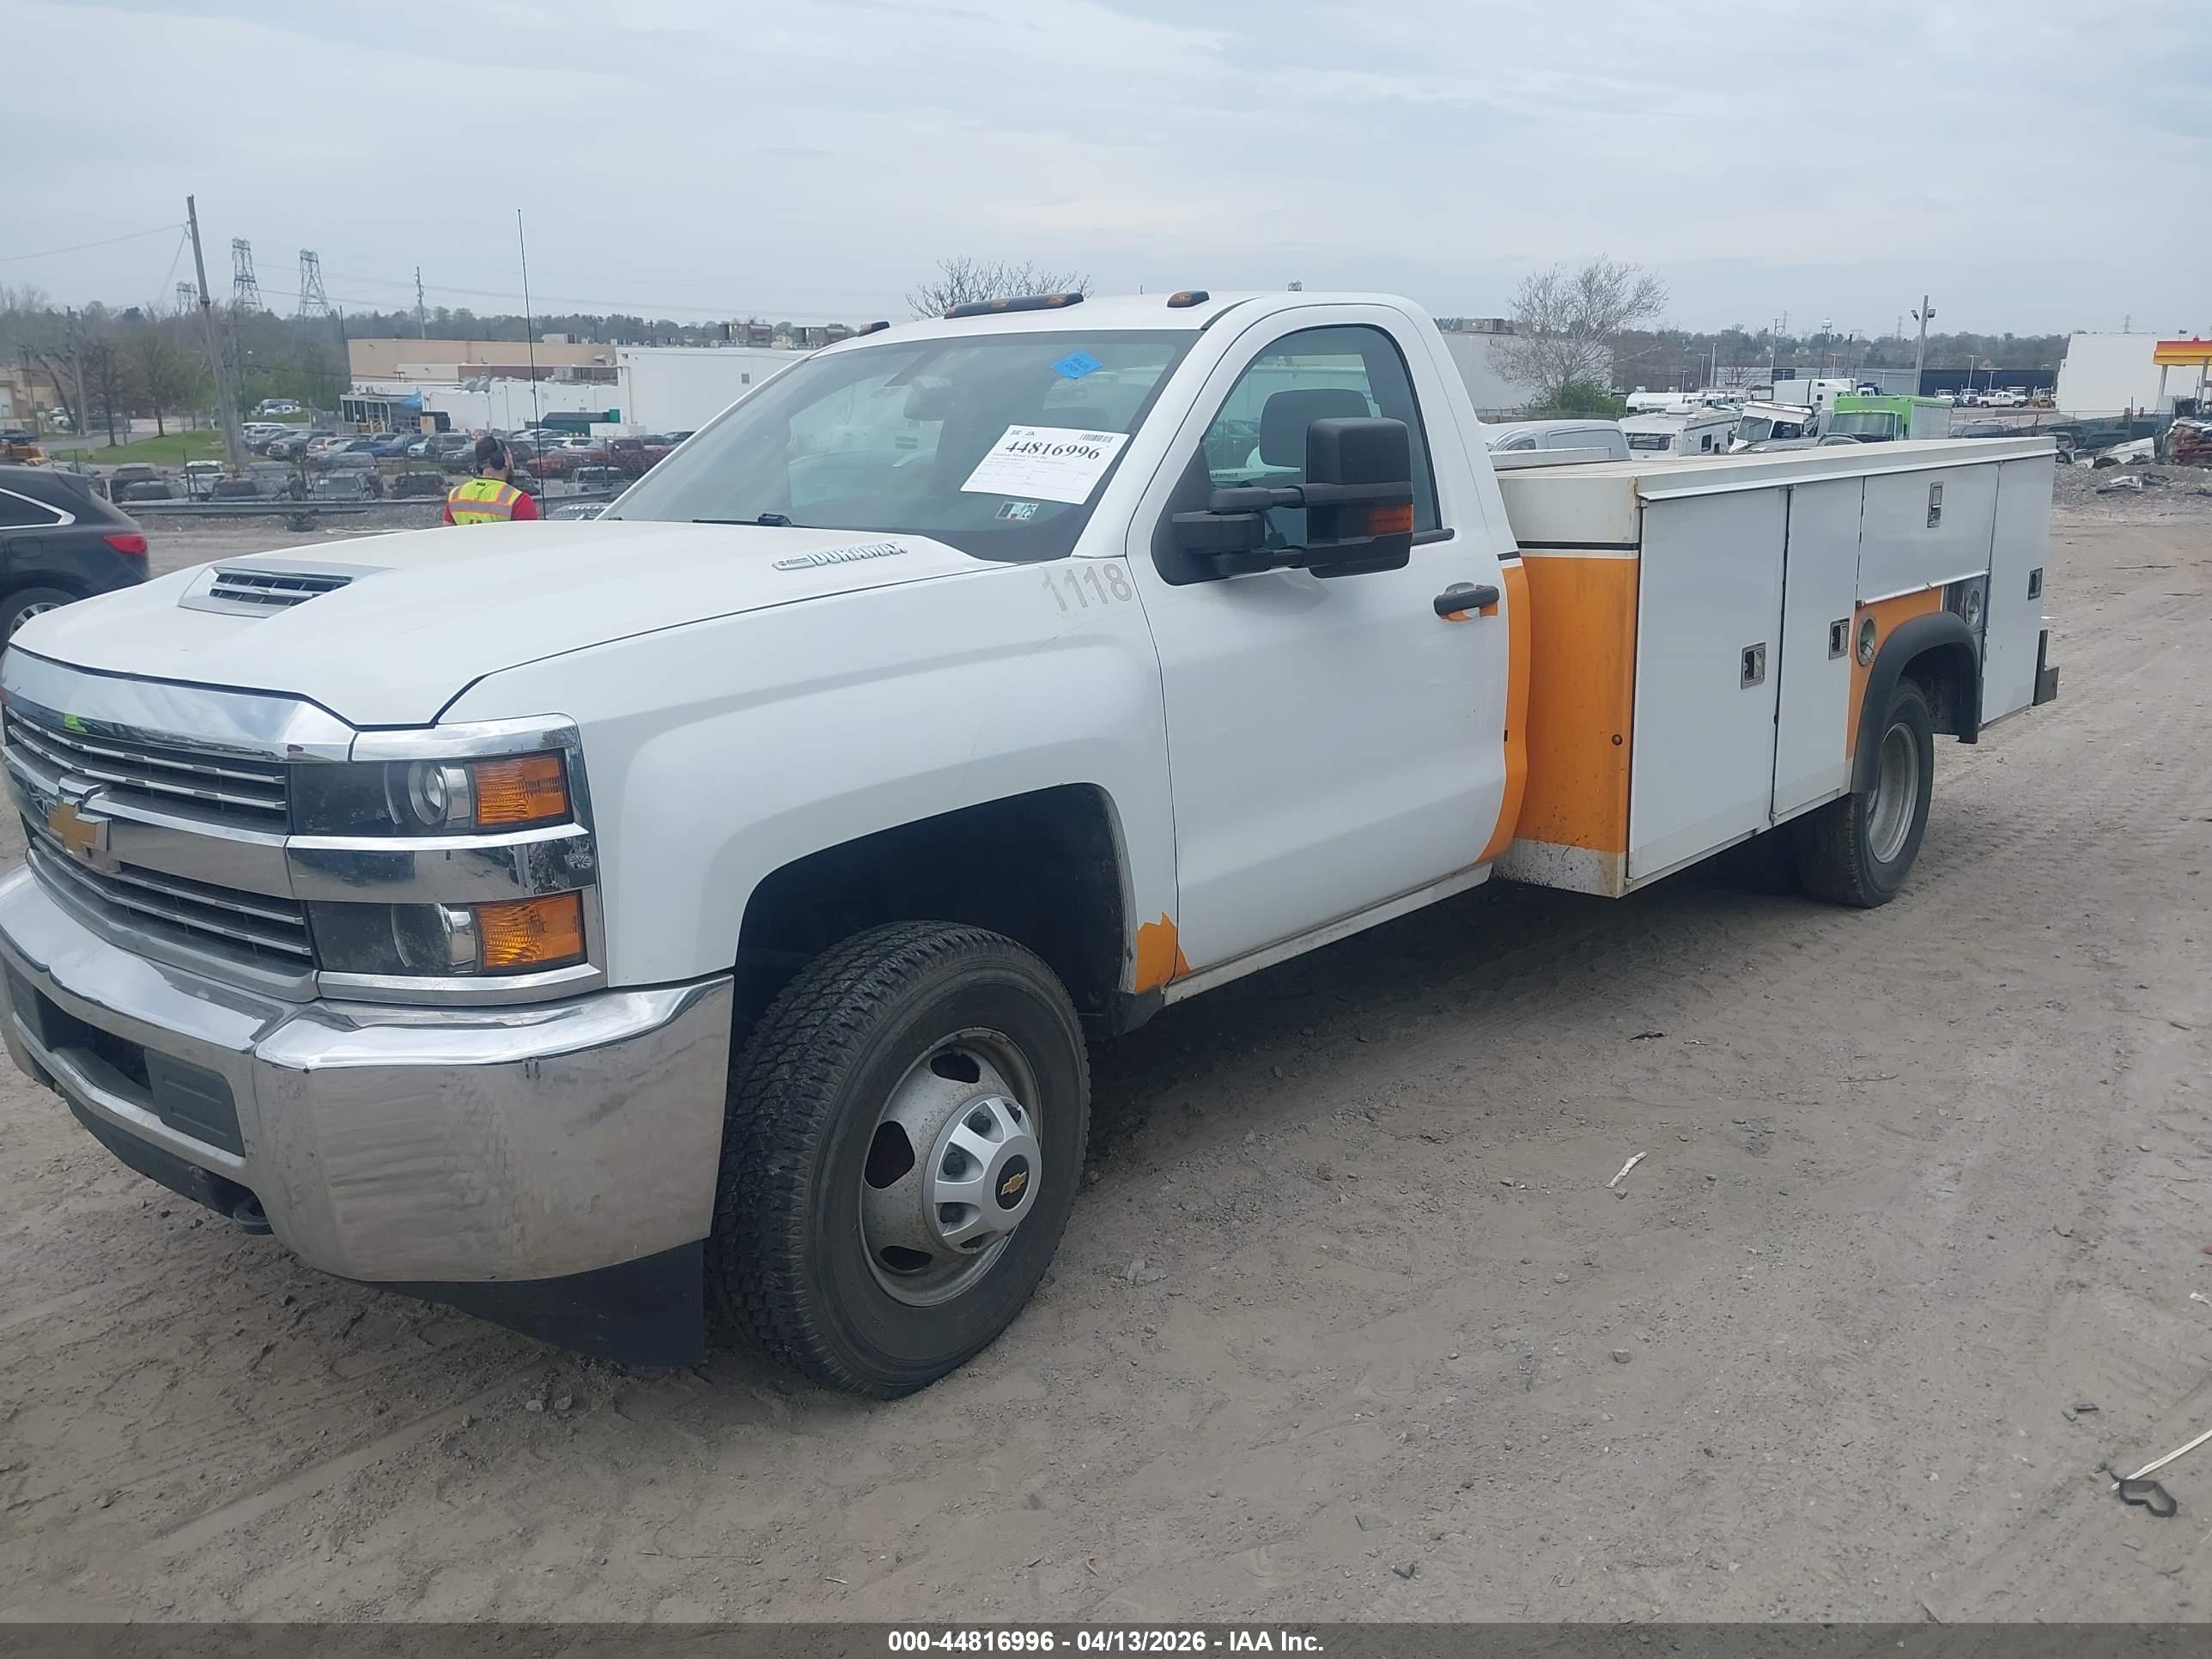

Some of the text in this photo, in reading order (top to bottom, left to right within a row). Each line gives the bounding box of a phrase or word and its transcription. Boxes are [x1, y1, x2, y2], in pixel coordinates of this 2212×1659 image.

[1005, 441, 1104, 460] 44816996
[808, 541, 908, 567] DURAMAX
[1039, 563, 1133, 612] 1118
